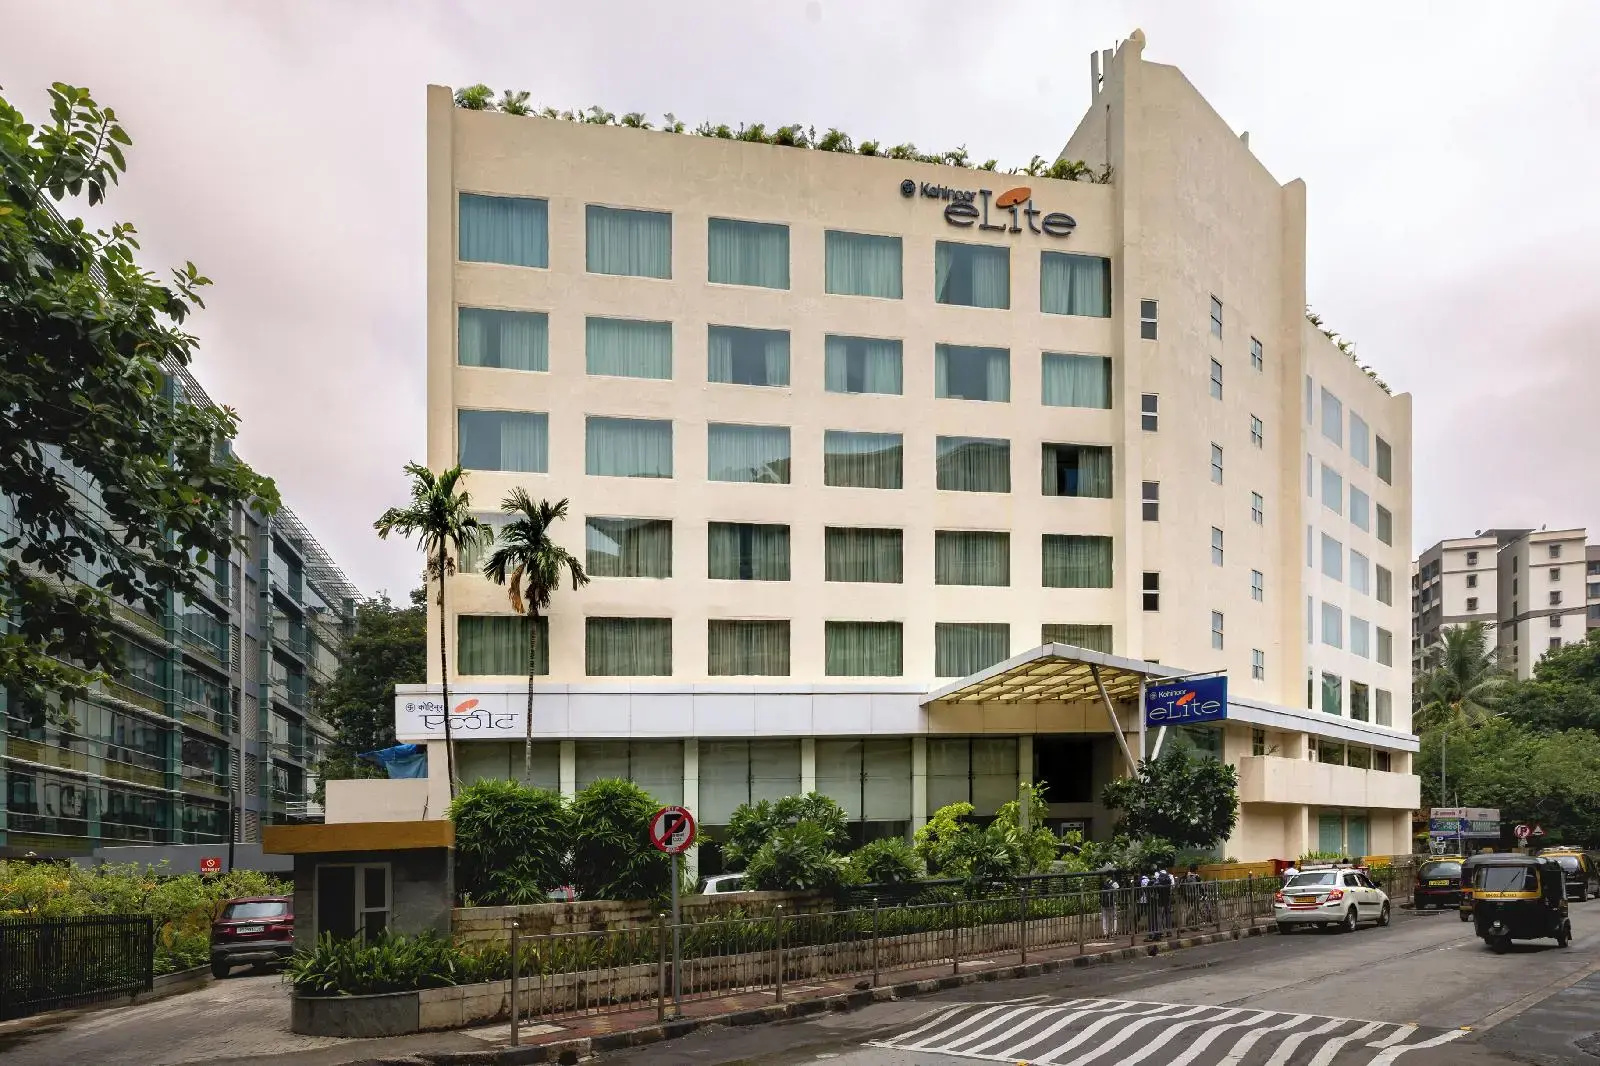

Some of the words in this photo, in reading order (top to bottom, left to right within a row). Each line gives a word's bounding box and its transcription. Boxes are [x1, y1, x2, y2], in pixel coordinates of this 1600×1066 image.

[920, 181, 977, 203] Kohinoor
[944, 188, 1077, 237] eLite
[1158, 689, 1187, 698] Kohinoor
[418, 701, 444, 713] कोहिनूर
[1149, 698, 1221, 720] eLite
